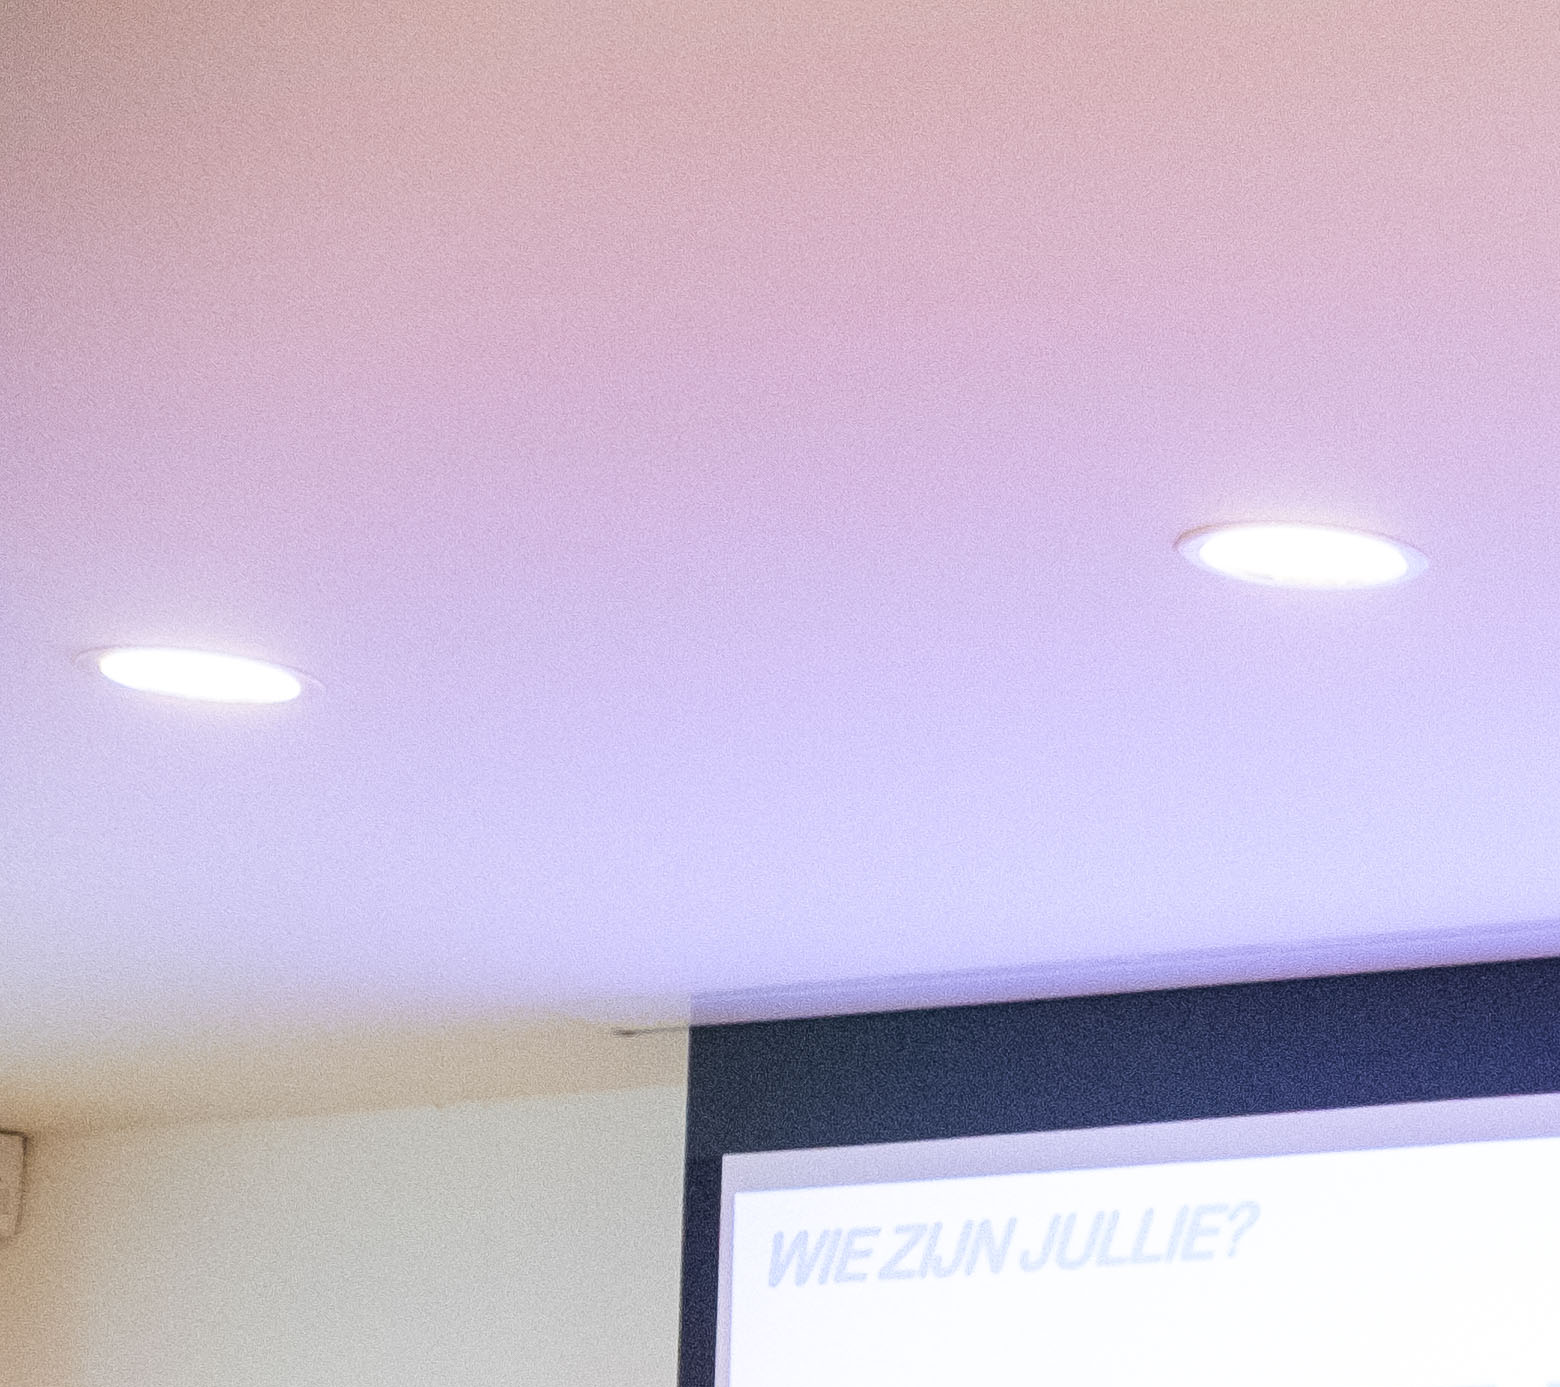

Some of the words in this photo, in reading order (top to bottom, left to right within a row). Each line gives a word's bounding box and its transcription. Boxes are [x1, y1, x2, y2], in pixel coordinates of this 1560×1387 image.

[767, 1228, 880, 1289] WIE
[876, 1216, 1018, 1282] ZIJN
[1019, 1200, 1261, 1273] JULLIE?
